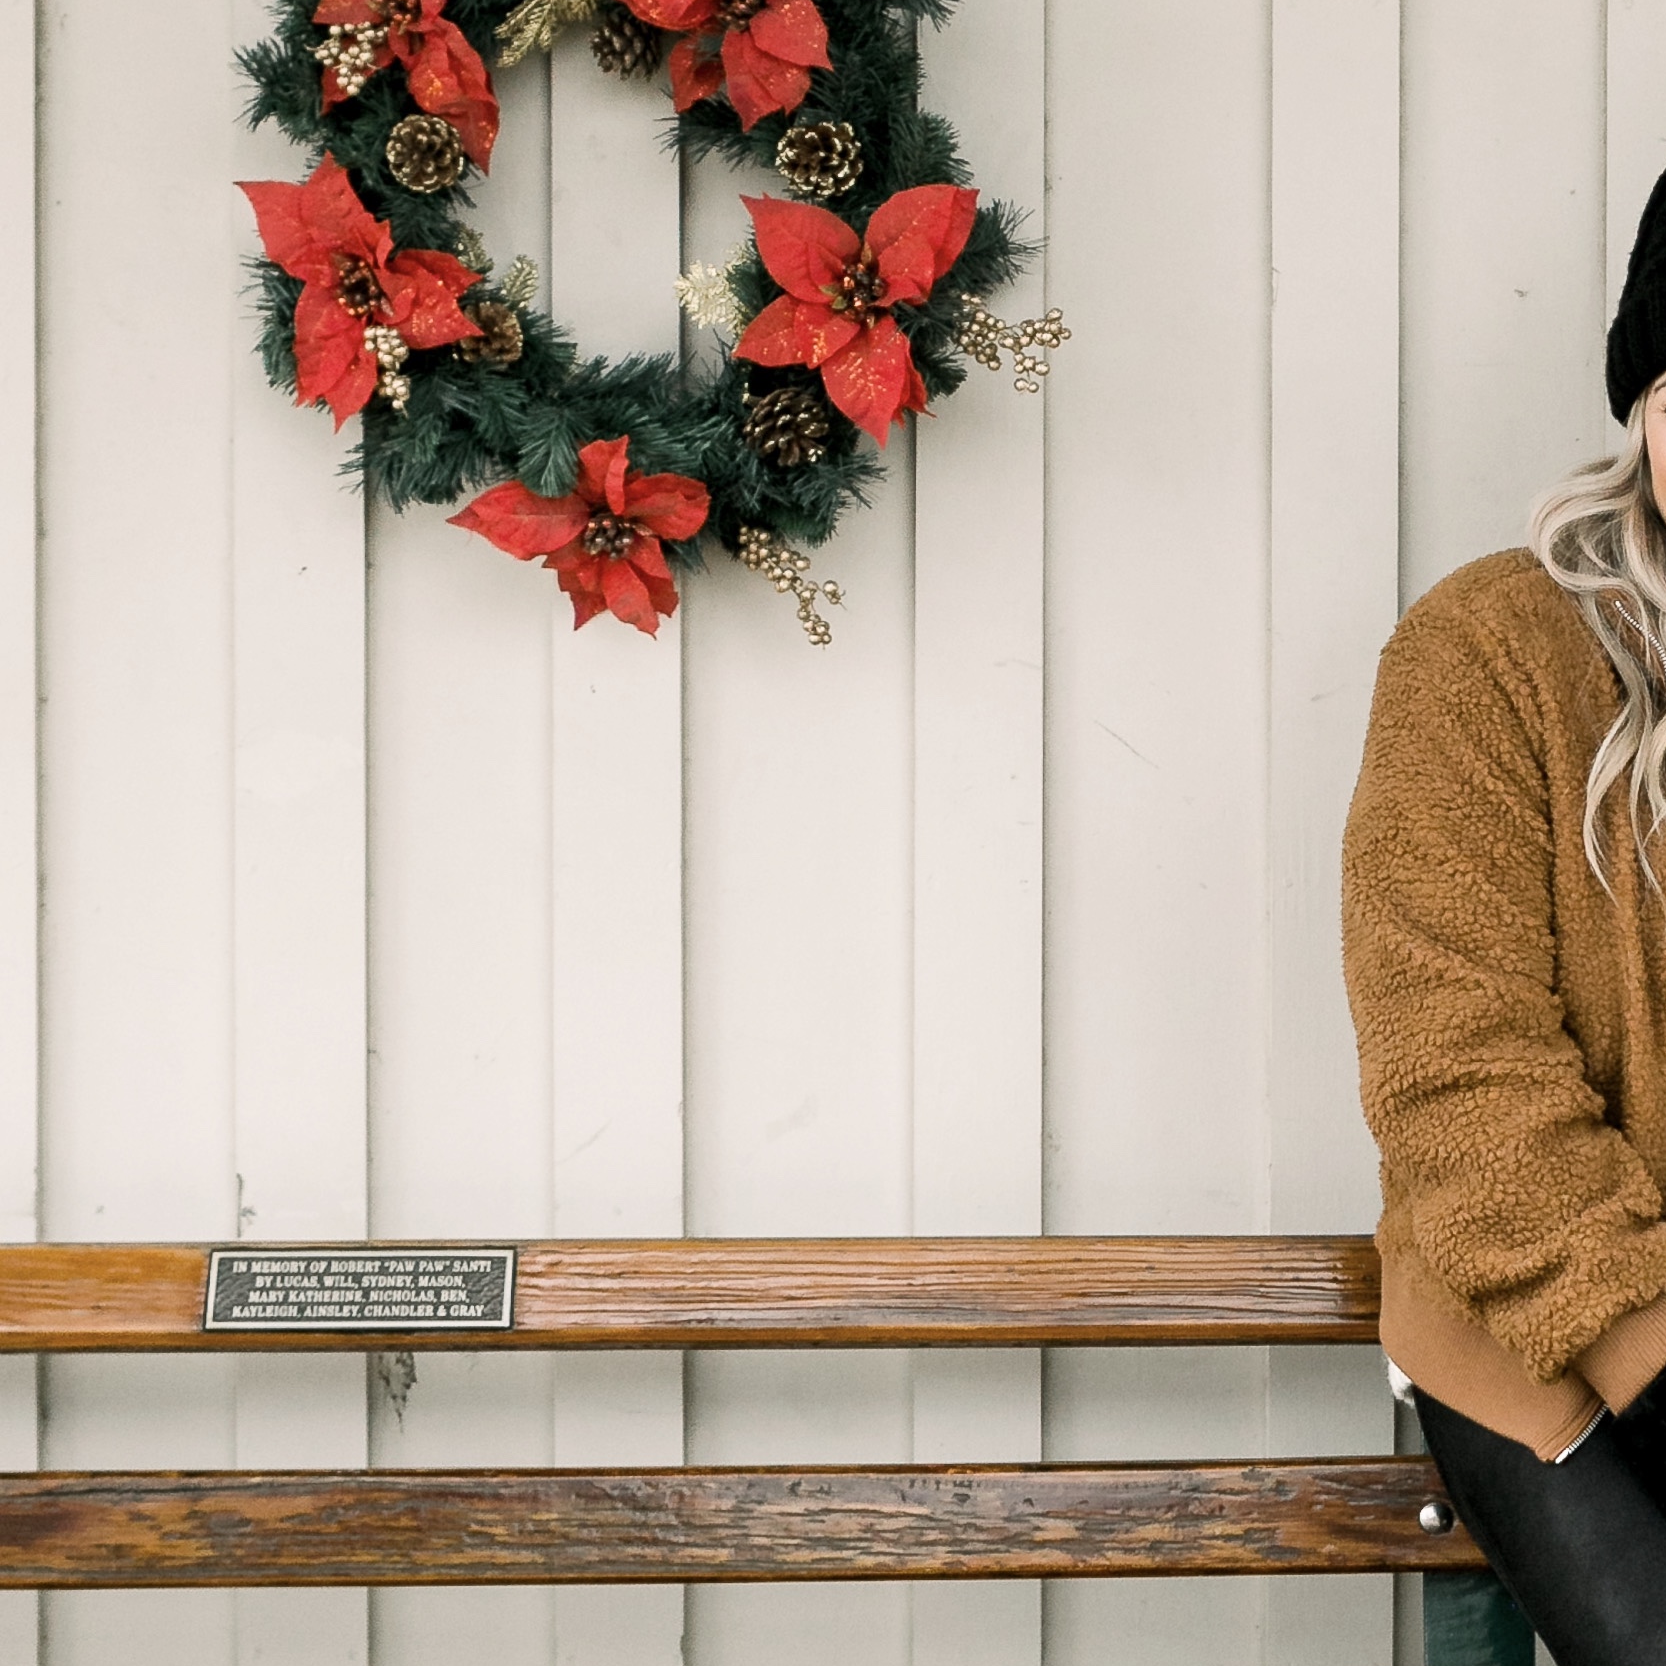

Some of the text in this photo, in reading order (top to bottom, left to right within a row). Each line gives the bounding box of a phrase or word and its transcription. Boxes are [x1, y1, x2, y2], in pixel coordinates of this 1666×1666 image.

[232, 1261, 248, 1273] IN
[251, 1261, 307, 1273] MEMORY
[310, 1261, 327, 1273] OF
[331, 1260, 381, 1273] ROBERT
[452, 1260, 491, 1272] SANTI
[255, 1275, 466, 1289] BY LUCAS, WILL, SYDNEY, MASON,
[248, 1290, 285, 1303] MARY
[369, 1290, 437, 1303] NICHOLAS,
[441, 1290, 470, 1303] BEN,
[232, 1304, 484, 1318] KAYLEIGH, AINSLEY, CHANDLER & GRAY
